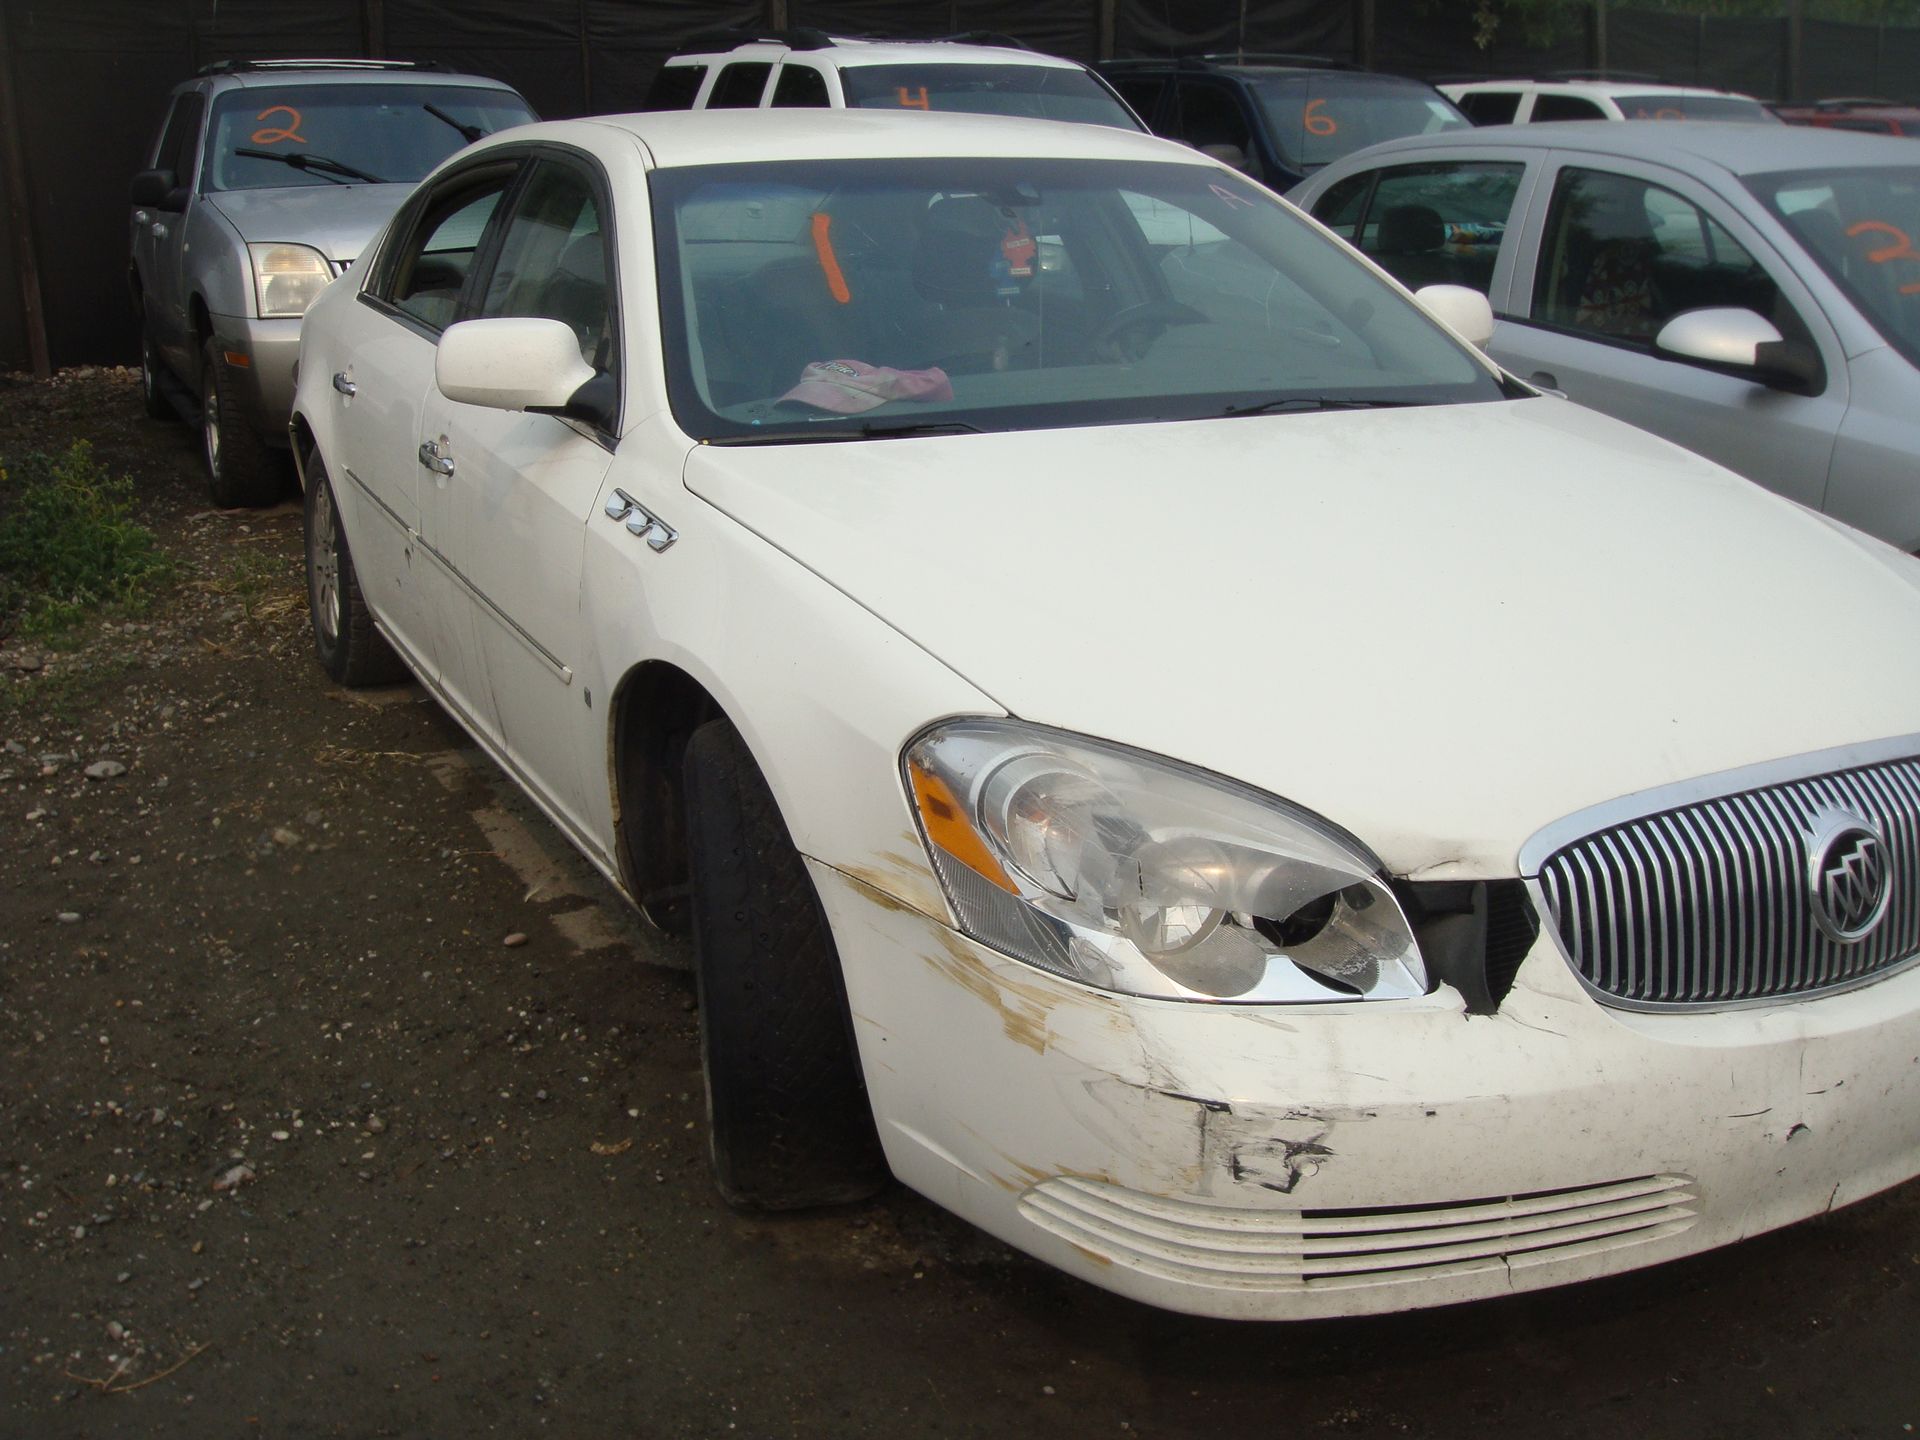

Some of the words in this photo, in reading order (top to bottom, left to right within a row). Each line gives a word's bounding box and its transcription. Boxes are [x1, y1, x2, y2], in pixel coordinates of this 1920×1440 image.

[900, 87, 929, 111] 4
[1303, 99, 1337, 135] 6
[252, 105, 307, 144] 2
